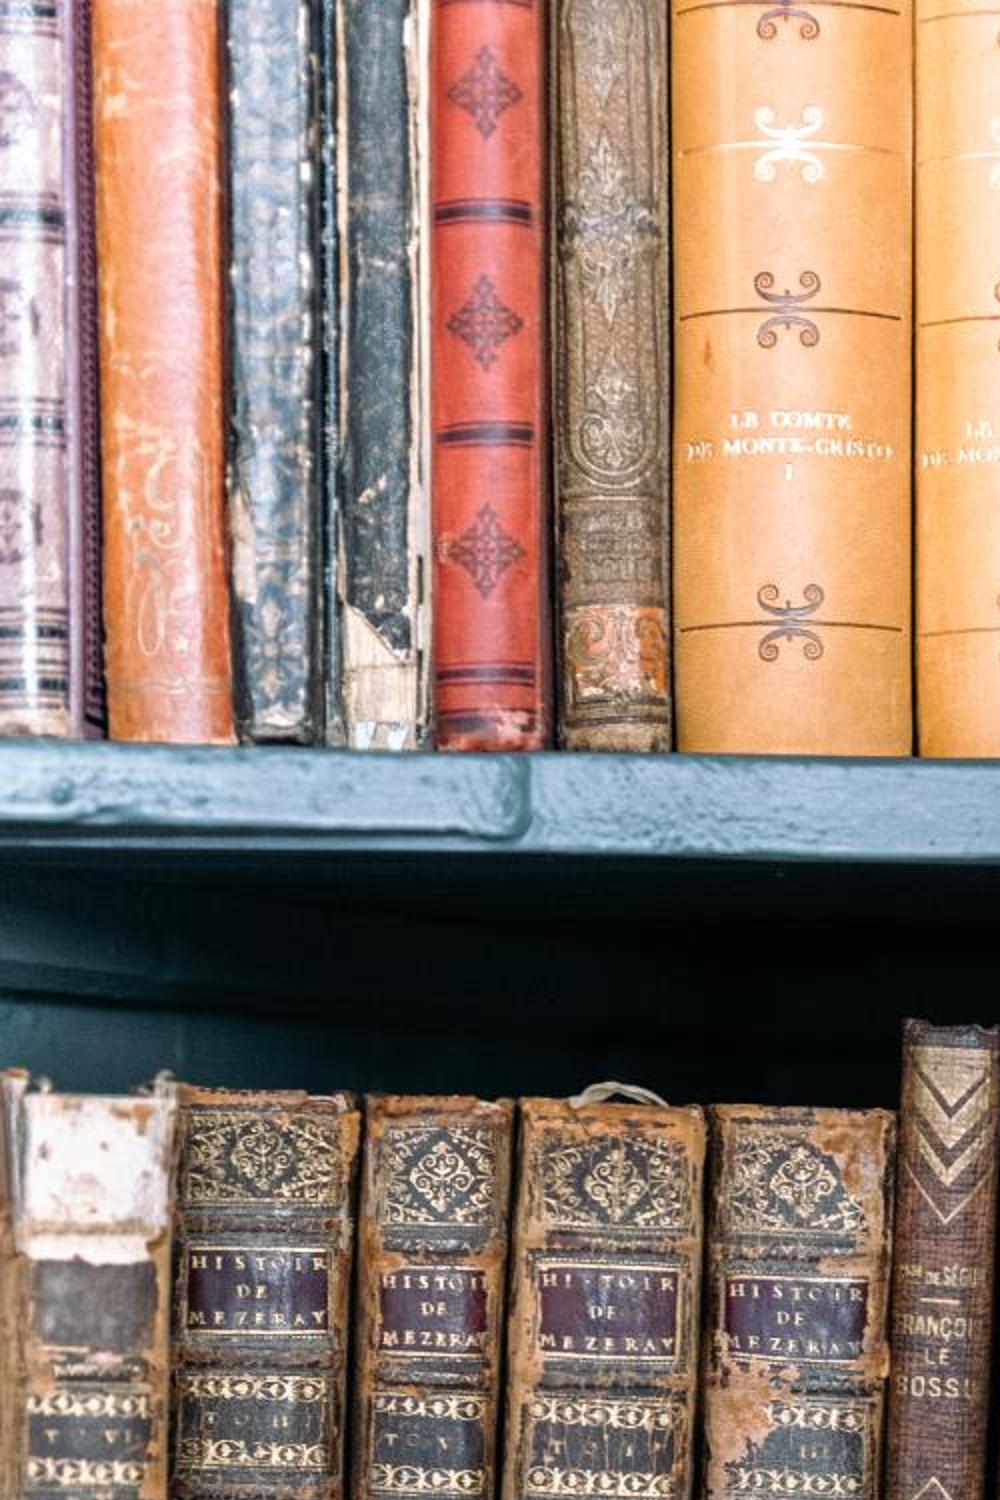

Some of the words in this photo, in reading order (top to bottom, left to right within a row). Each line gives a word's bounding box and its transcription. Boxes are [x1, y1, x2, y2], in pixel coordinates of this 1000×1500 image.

[730, 411, 758, 430] LE
[770, 410, 851, 430] COMTE
[784, 463, 793, 480] I
[236, 1284, 268, 1299] DE
[926, 1348, 951, 1366] LE
